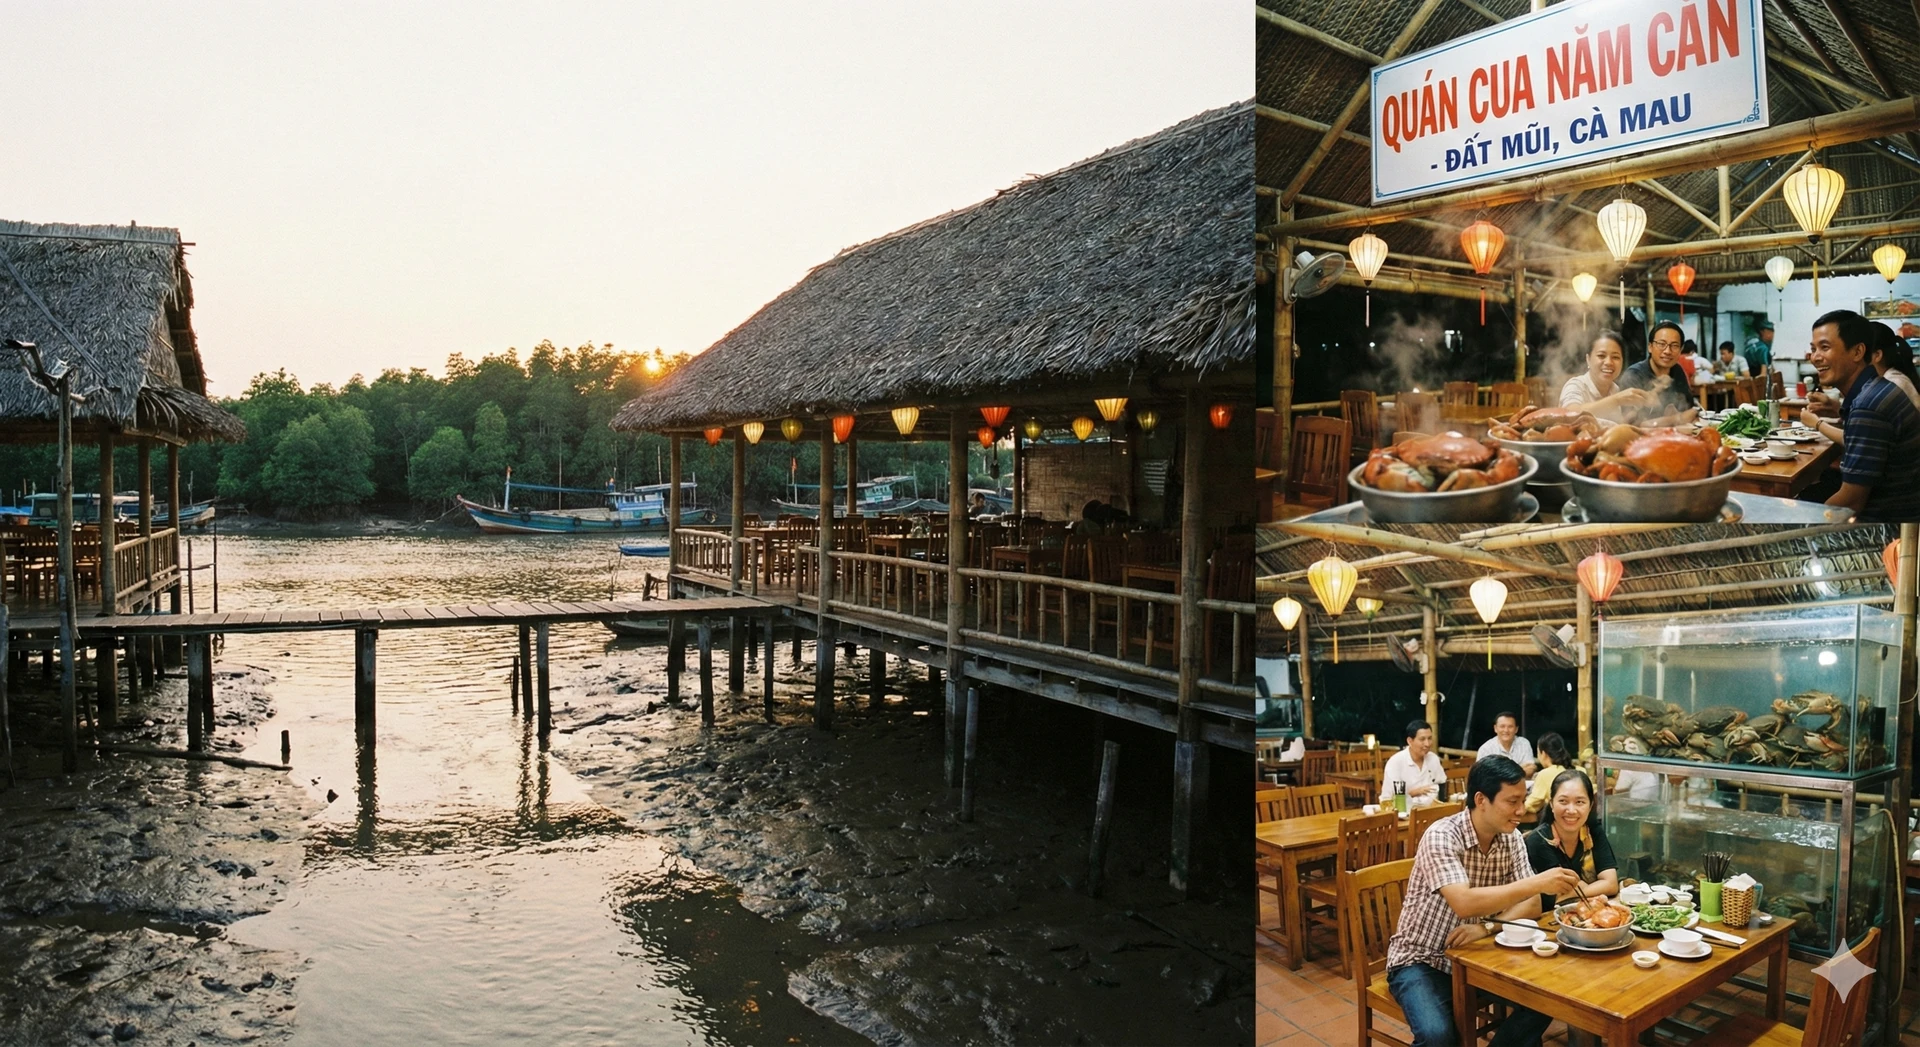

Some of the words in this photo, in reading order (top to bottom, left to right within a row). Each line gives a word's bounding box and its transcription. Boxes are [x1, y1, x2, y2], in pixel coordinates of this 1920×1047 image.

[1382, 69, 1458, 153] QUÁN
[1468, 54, 1536, 123] CUA
[1546, 23, 1632, 104] NĂM
[1444, 132, 1492, 172] ĐẤT
[1502, 122, 1559, 159] MŨI,
[1570, 106, 1609, 143] CÀ
[1620, 93, 1692, 133] MAU
